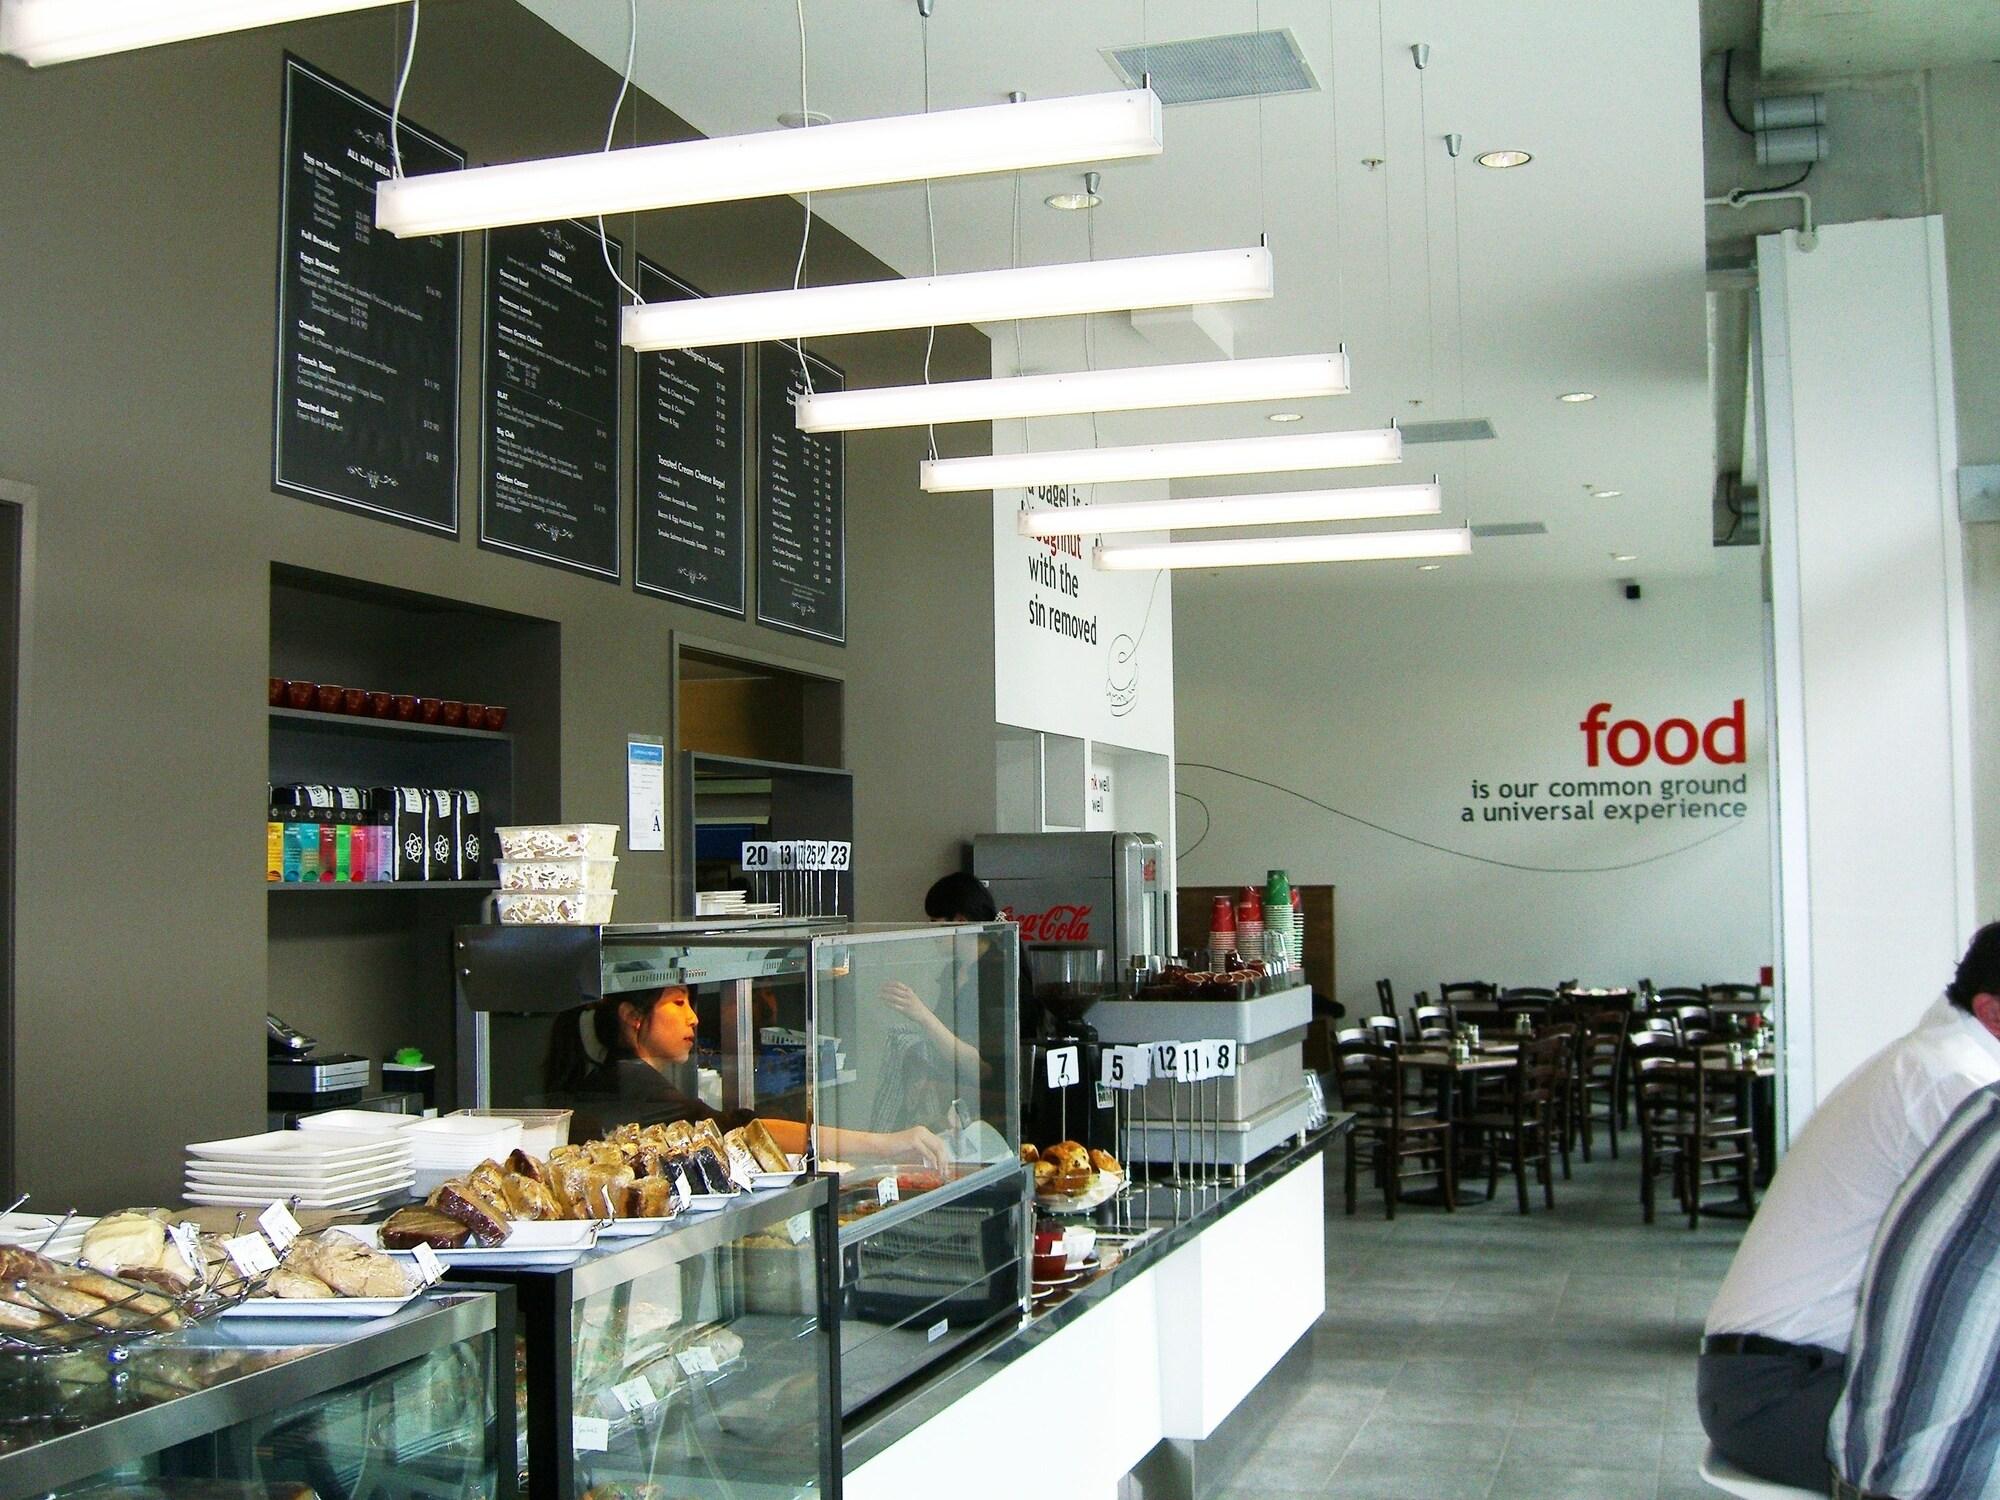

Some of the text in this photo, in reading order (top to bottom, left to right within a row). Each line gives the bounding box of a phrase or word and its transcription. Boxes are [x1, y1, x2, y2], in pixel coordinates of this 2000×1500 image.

[347, 146, 373, 169] ALL DAY
[301, 228, 311, 241] Full
[312, 233, 340, 253] Breakfast
[300, 250, 339, 277] Eggs Benedict
[548, 247, 566, 264] LUNCH
[297, 352, 317, 367] French
[681, 346, 706, 366] ultigrain
[707, 356, 724, 375] Toasties
[296, 397, 319, 413] Toasted
[496, 472, 513, 484] Chicken
[657, 453, 725, 490] Toasted Cream Cheese Bagel
[1030, 533, 1082, 560] oughnut
[1028, 553, 1079, 599] with the
[1028, 593, 1097, 646] sin removed
[1579, 698, 1747, 767] food
[1471, 773, 1748, 801] is our common ground
[652, 814, 661, 832] A
[1460, 799, 1749, 825] a universal experience
[746, 845, 768, 865] 20
[780, 844, 791, 865] 13
[806, 844, 816, 865] 25
[830, 845, 848, 866] 23
[1056, 1053, 1069, 1078] 7
[1112, 1054, 1124, 1081] 5
[1157, 1045, 1178, 1071] 12
[1184, 1048, 1199, 1074] 11
[1217, 1044, 1230, 1069] 8
